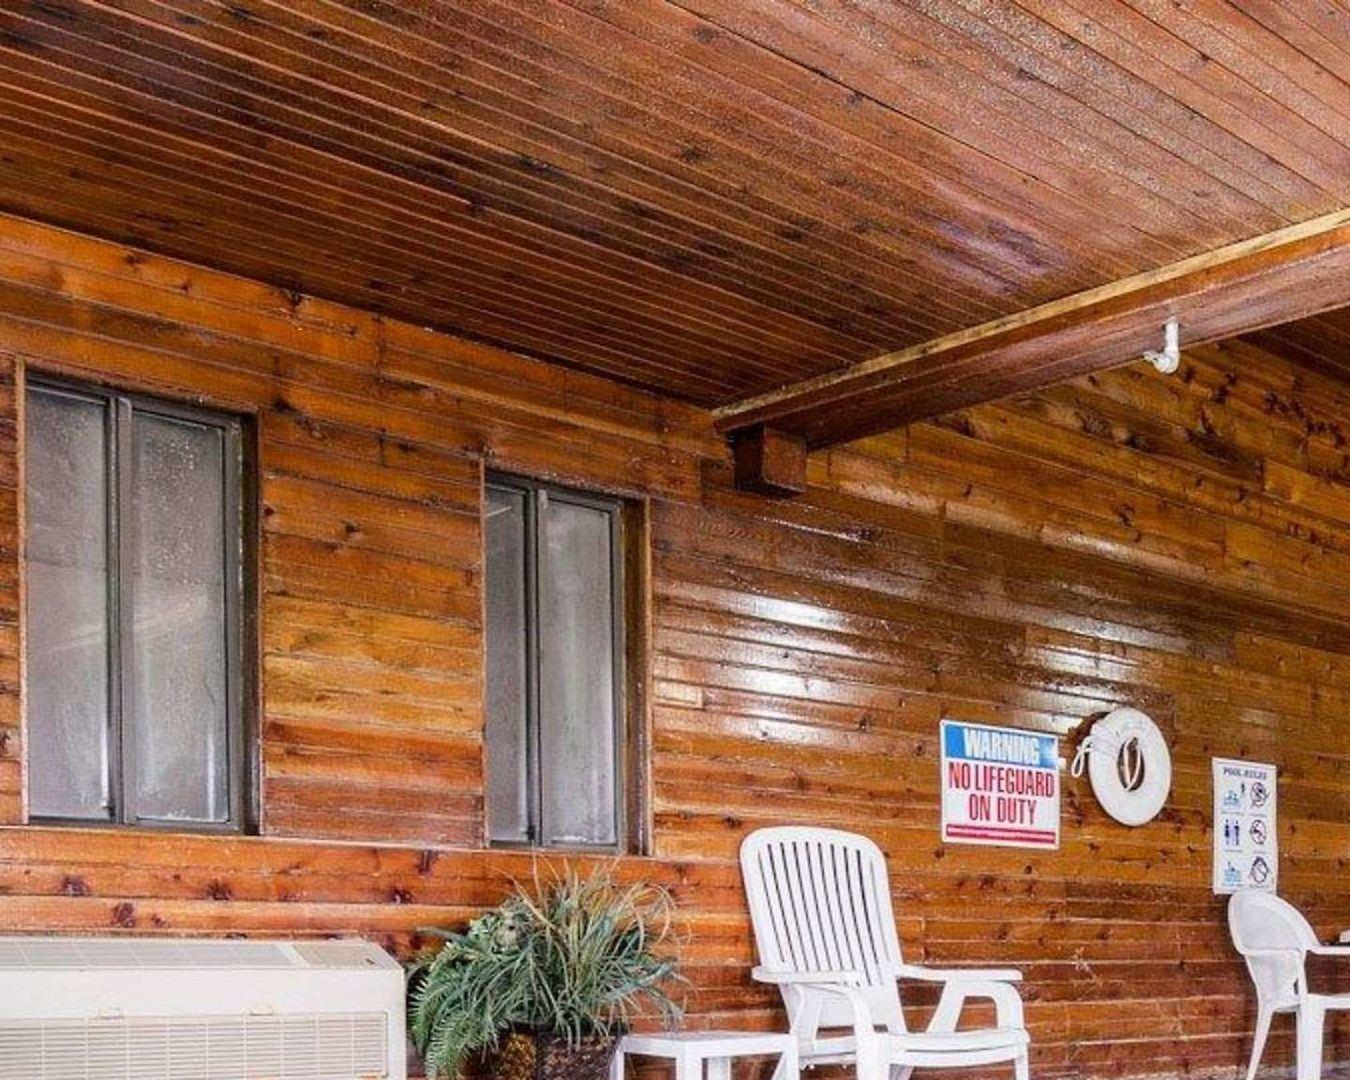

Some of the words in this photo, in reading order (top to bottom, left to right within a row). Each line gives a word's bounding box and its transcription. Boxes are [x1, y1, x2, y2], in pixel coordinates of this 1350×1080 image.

[963, 728, 1040, 766] WARNING
[948, 761, 971, 790] NO
[975, 763, 1055, 798] LIFEGUARD
[969, 793, 991, 821] ON
[997, 796, 1037, 825] DUTY
